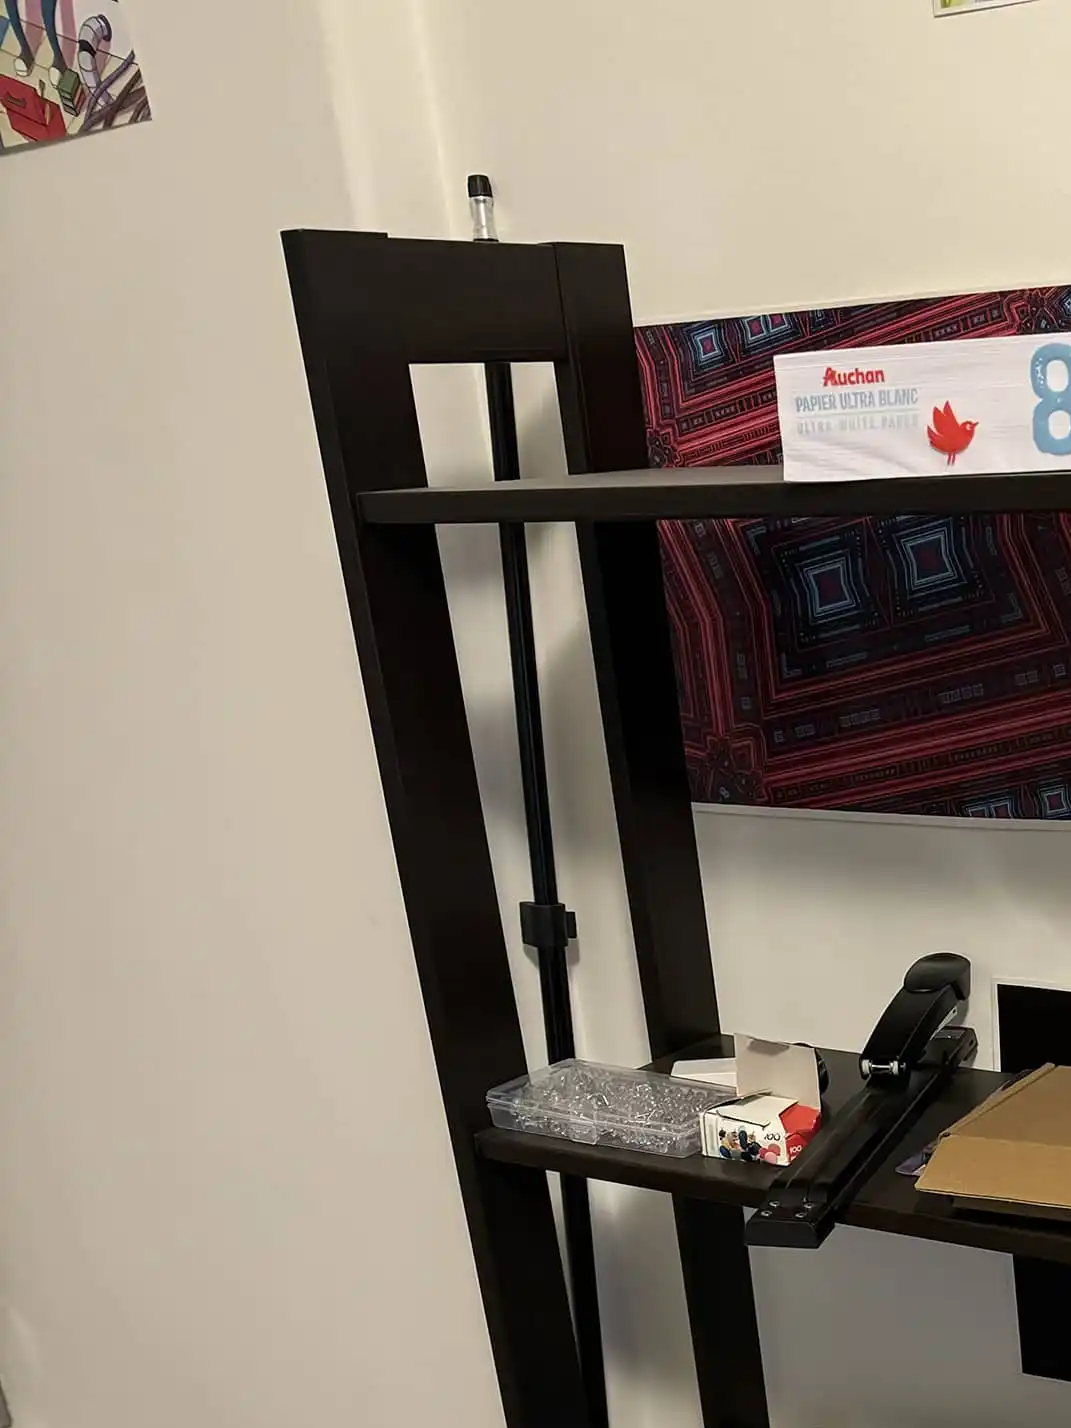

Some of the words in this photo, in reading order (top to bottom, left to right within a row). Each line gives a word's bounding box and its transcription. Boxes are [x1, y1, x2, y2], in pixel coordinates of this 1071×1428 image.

[823, 367, 885, 386] Auchan
[796, 393, 837, 412] PAPIER
[840, 390, 877, 409] ULTRA
[878, 388, 918, 406] BLANC
